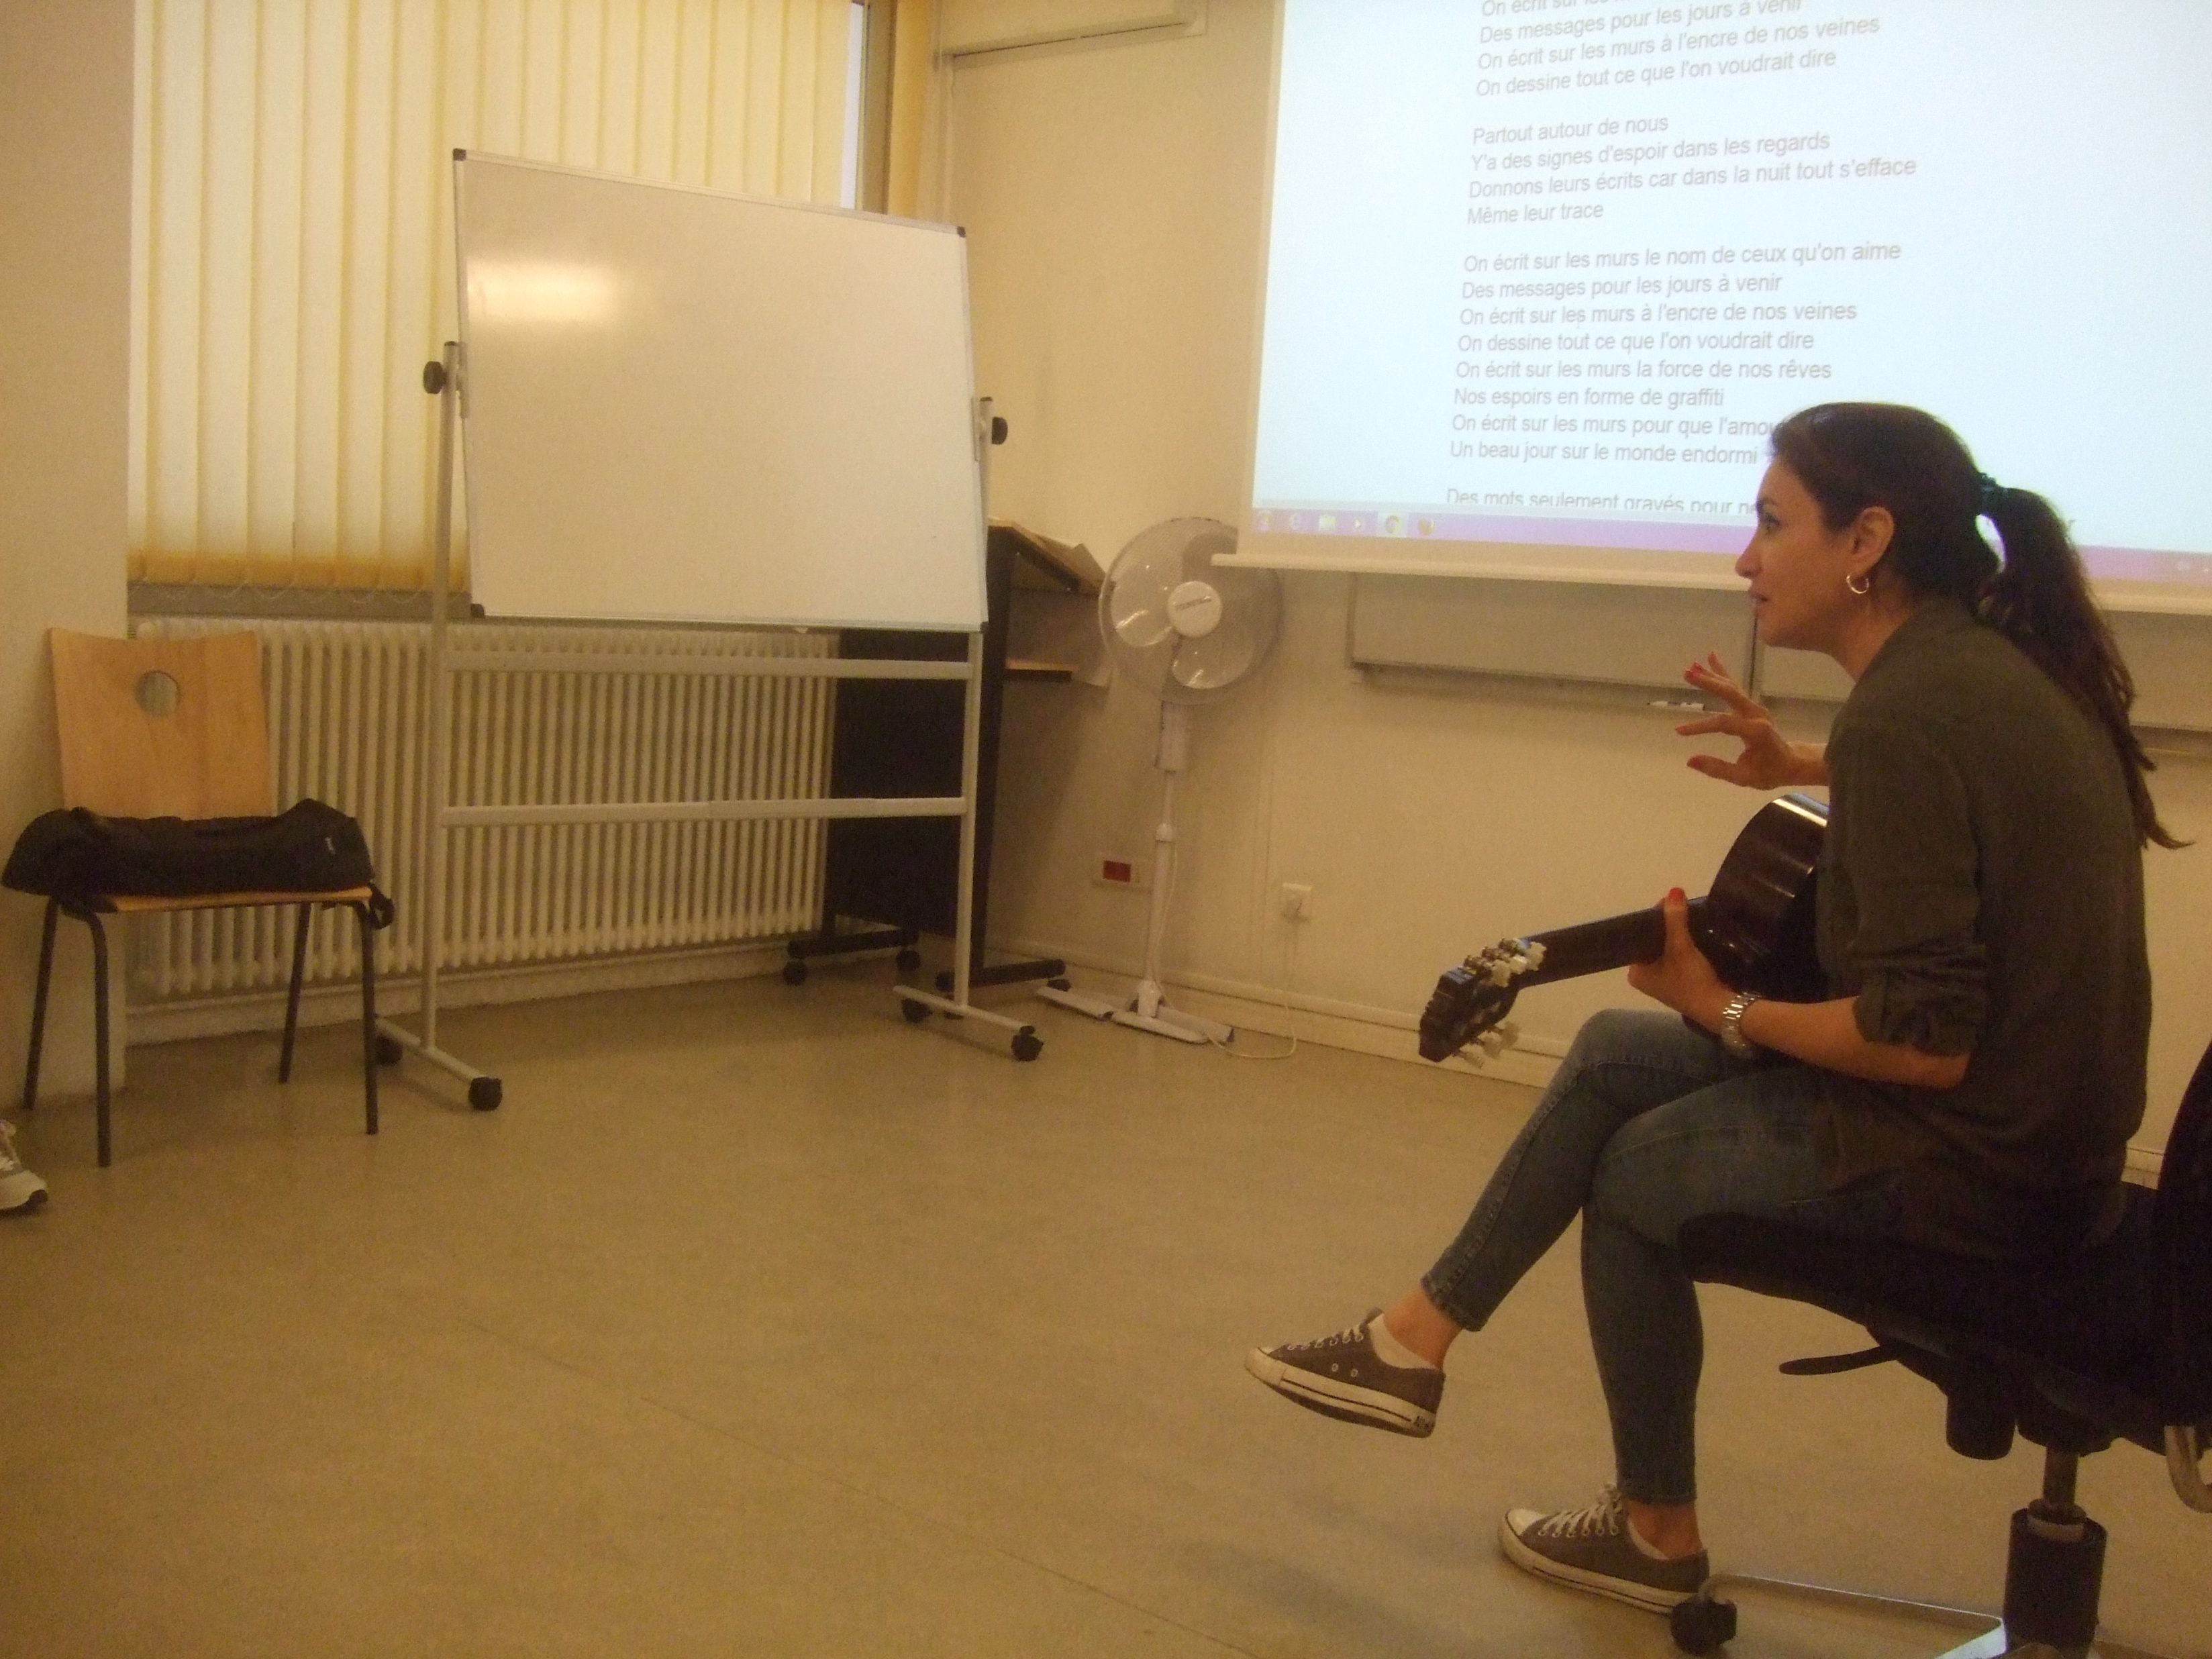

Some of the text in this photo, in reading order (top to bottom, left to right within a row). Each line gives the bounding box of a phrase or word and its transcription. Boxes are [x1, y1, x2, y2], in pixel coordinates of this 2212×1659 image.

[1481, 0, 1507, 17] On
[1480, 26, 1513, 44] Des
[1518, 17, 1606, 40] messages
[1610, 11, 1652, 34] pour
[1656, 7, 1682, 25] les
[1686, 3, 1733, 27] jours
[1478, 17, 1880, 70] On écrit sur les murs à l'encre de nos veines
[1476, 49, 1837, 97] On dessine tout ce que l'on voudrait dire
[1473, 117, 1668, 145] Partout autour de nous
[1471, 131, 1831, 171] Y'a des signes d'espoir dans les regards
[1469, 156, 1917, 199] Donnons leurs écrits car dans la nuit tout s'efface
[1467, 203, 1604, 224] Même leur trace
[1464, 241, 1902, 272] On écrit sur les murs le nom de ceux qu'on aime
[1462, 272, 1783, 301] Des messages pour les jours à venir
[1460, 301, 1858, 325] On écrit sur les murs à l'encre de nos veines
[1458, 330, 1815, 354] On dessine tout ce que l'on voudrait dire
[1456, 358, 1832, 379] On écrit sur les murs la force de nos rêves
[1454, 387, 1724, 411] Nos espoirs en forme de graffiti
[1452, 413, 1476, 431] On
[1480, 413, 1517, 432] écrit
[1521, 418, 1549, 432] sur
[1553, 415, 1578, 432] les
[1582, 419, 1627, 433] murs
[1631, 419, 1674, 438] pour
[1677, 420, 1713, 439] que
[1450, 441, 1758, 464] Un beau jour sur le monde endormi
[1446, 488, 1479, 505] Des
[1483, 491, 1524, 506] mots
[1529, 491, 1619, 509] seulement
